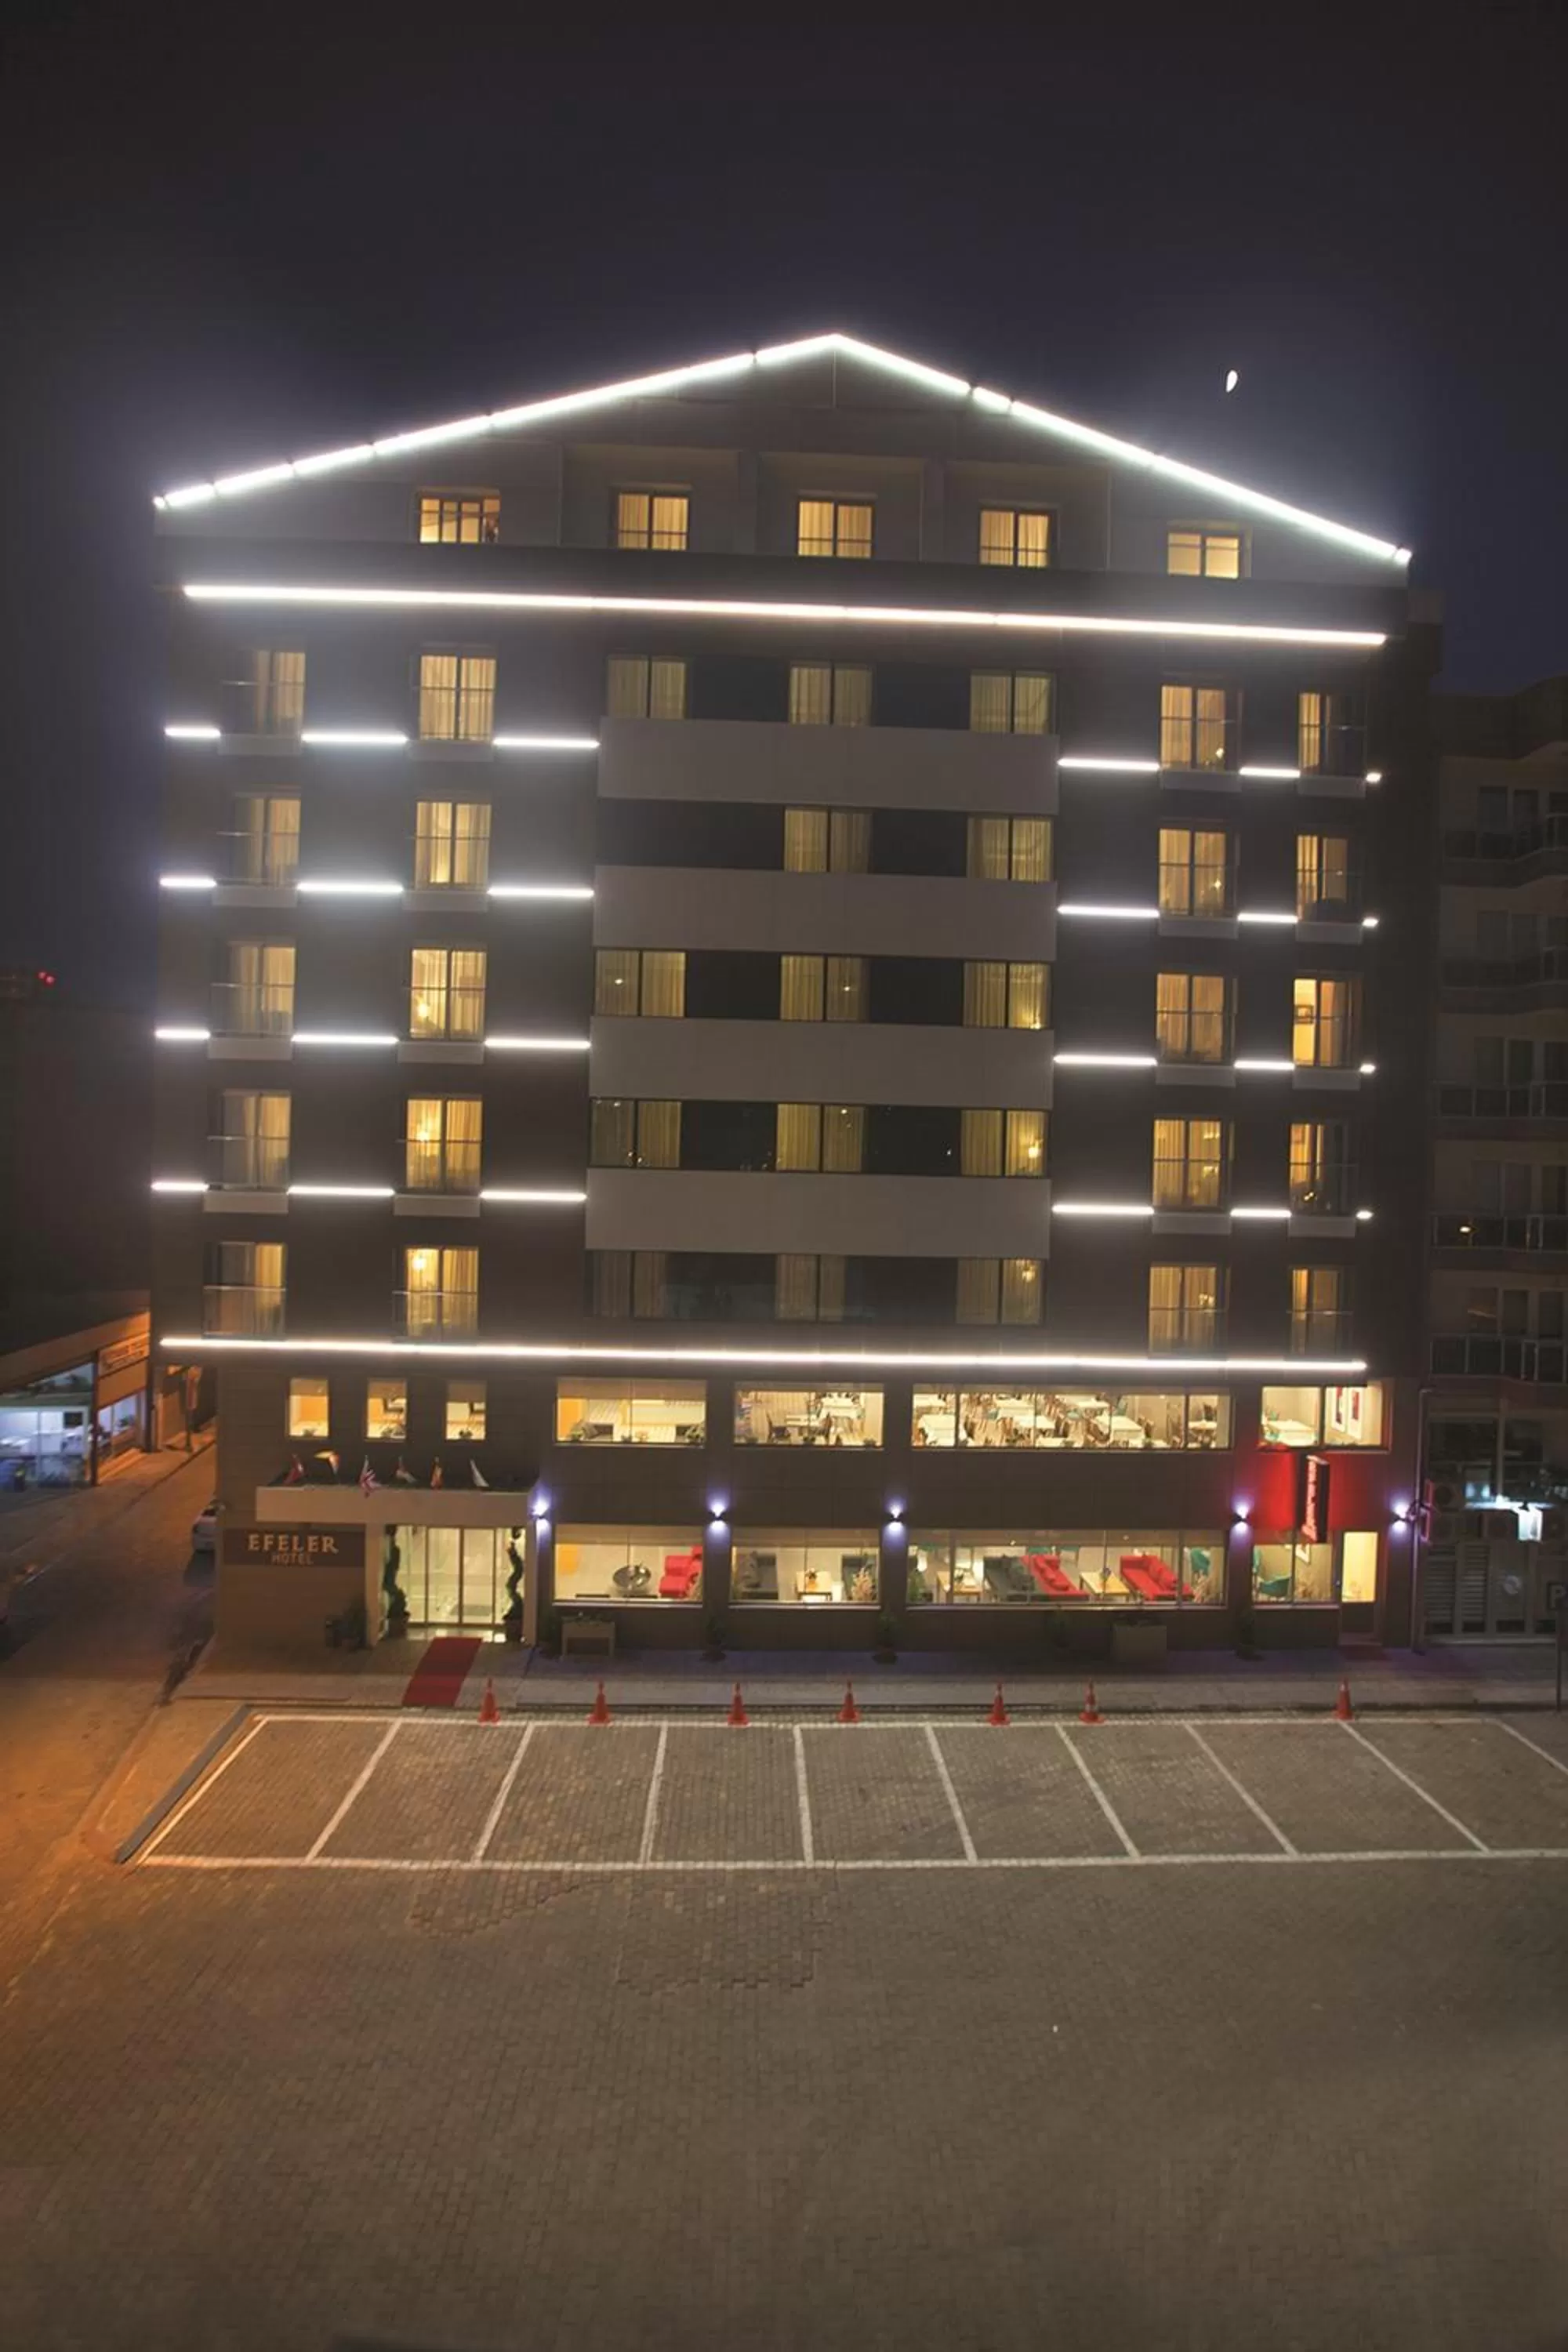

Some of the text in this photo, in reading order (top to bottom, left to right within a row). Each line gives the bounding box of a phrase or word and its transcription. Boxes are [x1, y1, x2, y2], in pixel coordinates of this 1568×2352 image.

[248, 1533, 339, 1554] EFELER
[271, 1553, 314, 1565] HOTEL
[1551, 1584, 1567, 1608] P
